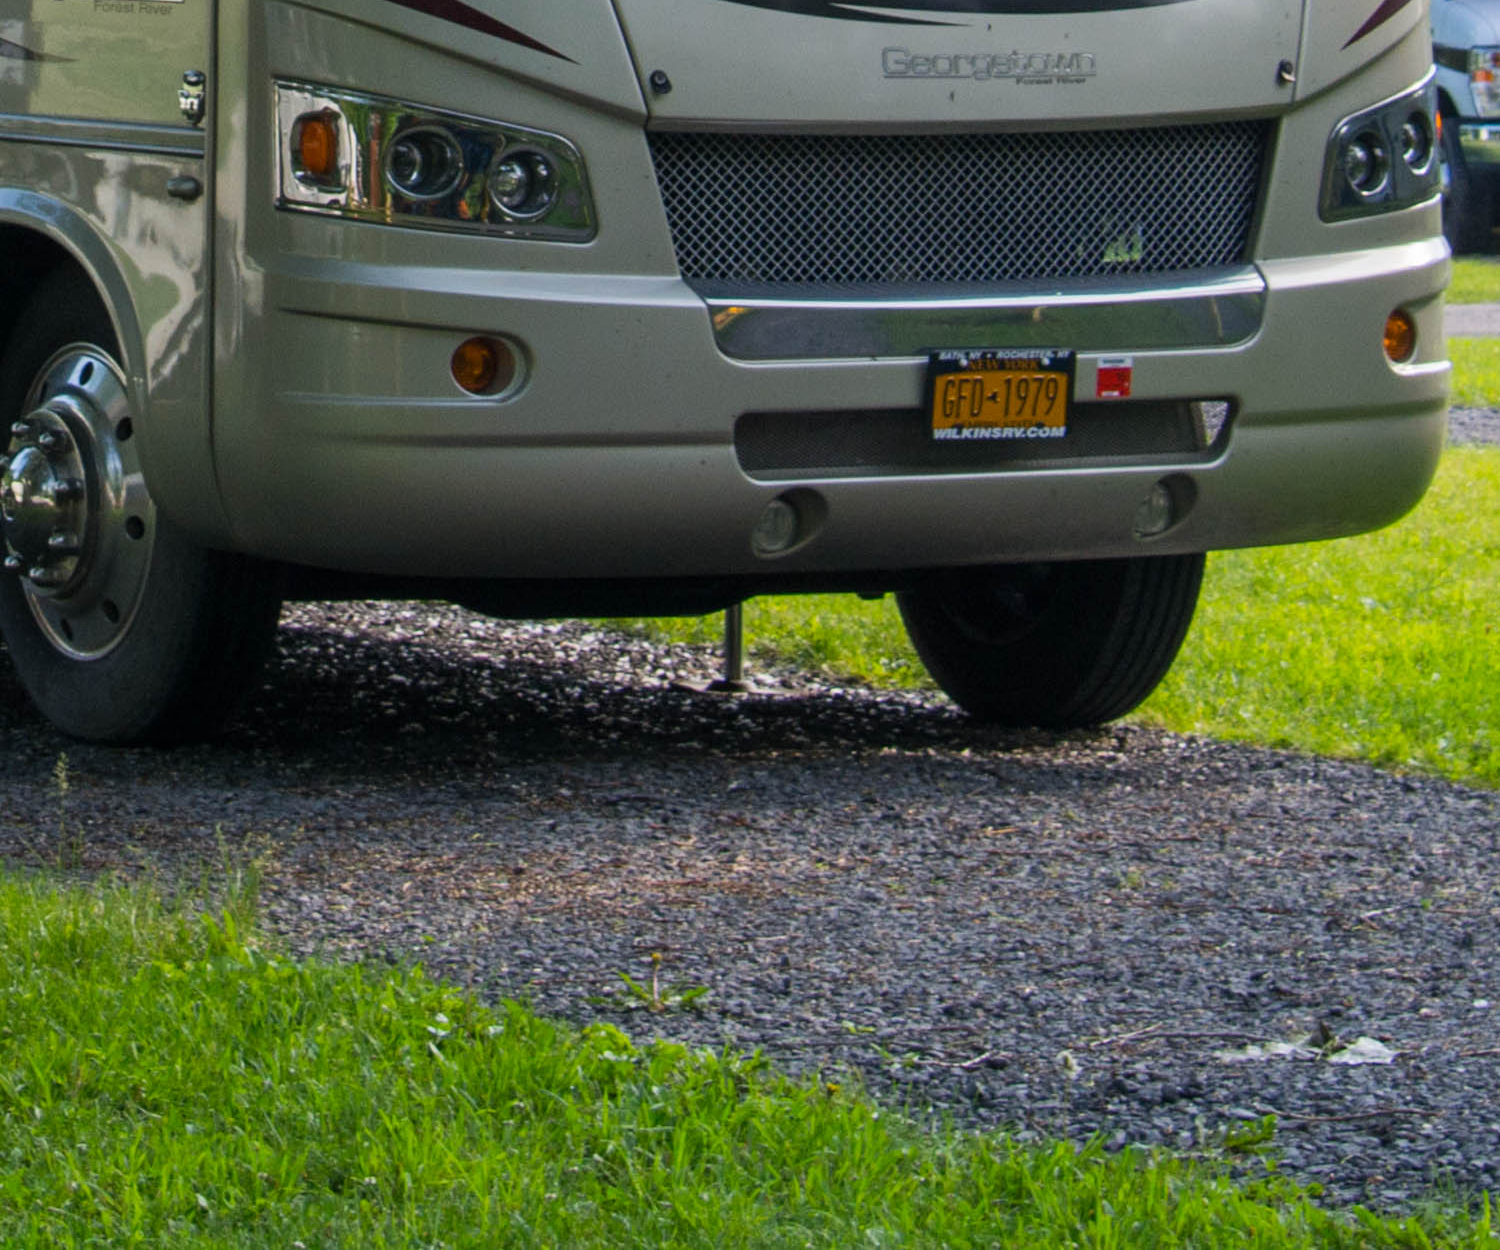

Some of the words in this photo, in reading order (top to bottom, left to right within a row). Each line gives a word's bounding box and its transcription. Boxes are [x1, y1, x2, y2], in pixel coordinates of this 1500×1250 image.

[139, 2, 173, 15] River
[881, 46, 1097, 81] Georgetown
[970, 359, 999, 370] NEW
[1004, 358, 1039, 370] YORK
[933, 426, 1067, 440] WILKINSRV.COM
